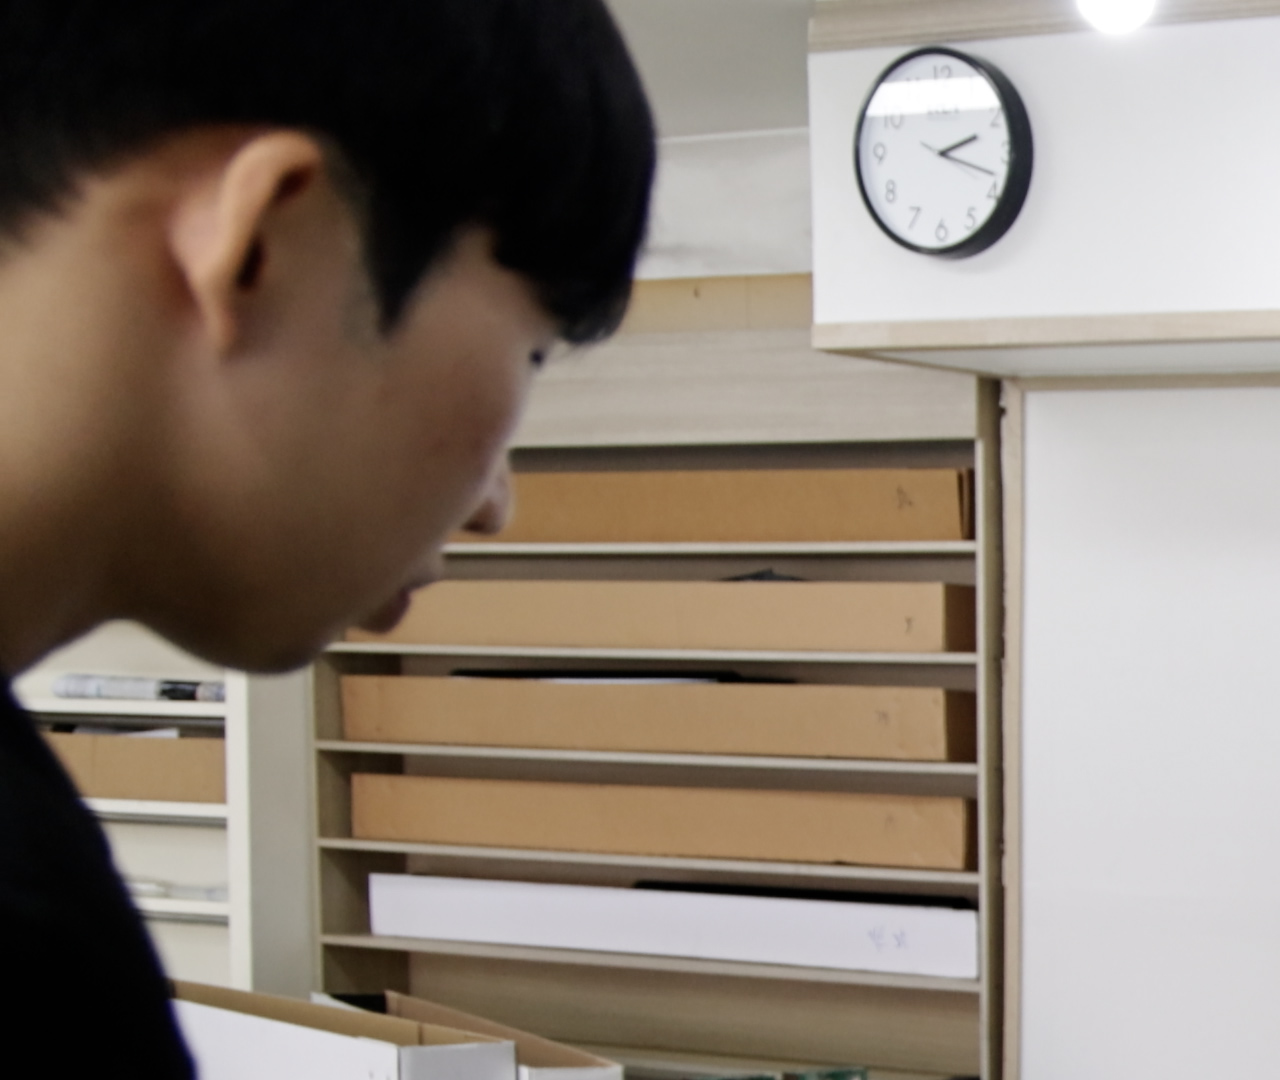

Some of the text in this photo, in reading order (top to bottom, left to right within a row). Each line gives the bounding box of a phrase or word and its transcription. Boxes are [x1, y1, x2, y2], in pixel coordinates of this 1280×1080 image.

[872, 142, 886, 165] 9
[885, 178, 896, 204] 8
[985, 179, 1000, 201] 4
[908, 205, 922, 230] 7
[934, 217, 949, 243] 6
[964, 206, 977, 231] 5
